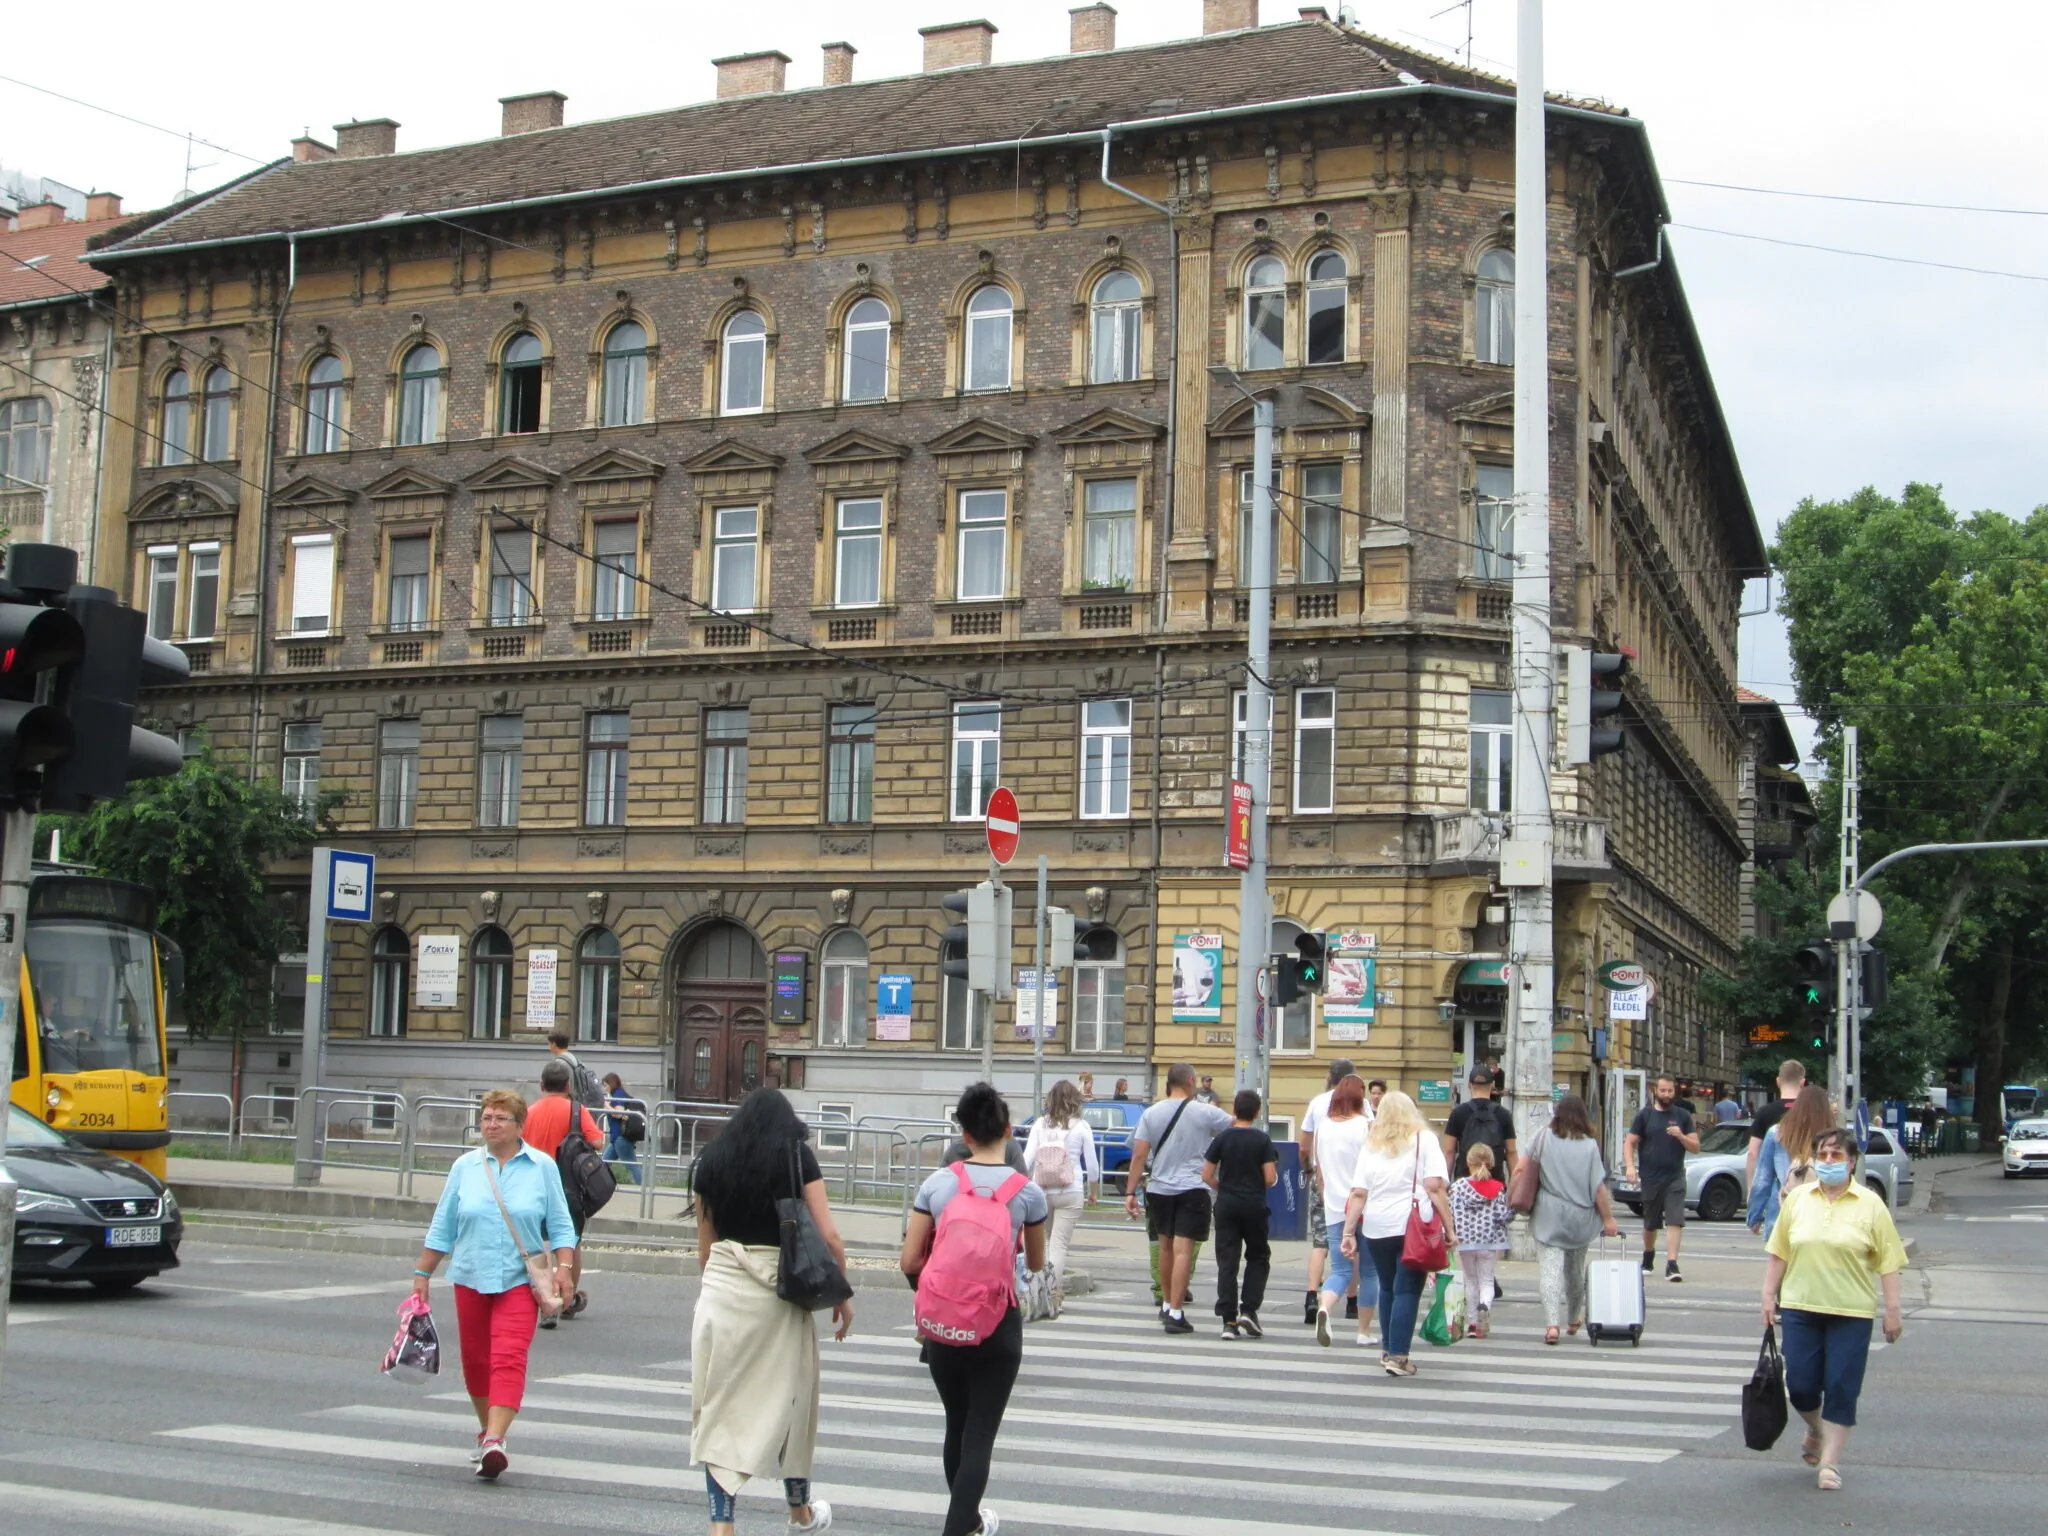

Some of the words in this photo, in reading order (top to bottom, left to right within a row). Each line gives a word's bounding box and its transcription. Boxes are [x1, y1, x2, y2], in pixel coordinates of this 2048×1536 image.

[1190, 935, 1220, 947] PONT
[1341, 935, 1372, 947] PONT
[1611, 970, 1641, 981] PONT
[79, 1112, 115, 1127] 2034
[113, 1227, 159, 1243] RDE-858
[921, 1318, 977, 1341] adidas
